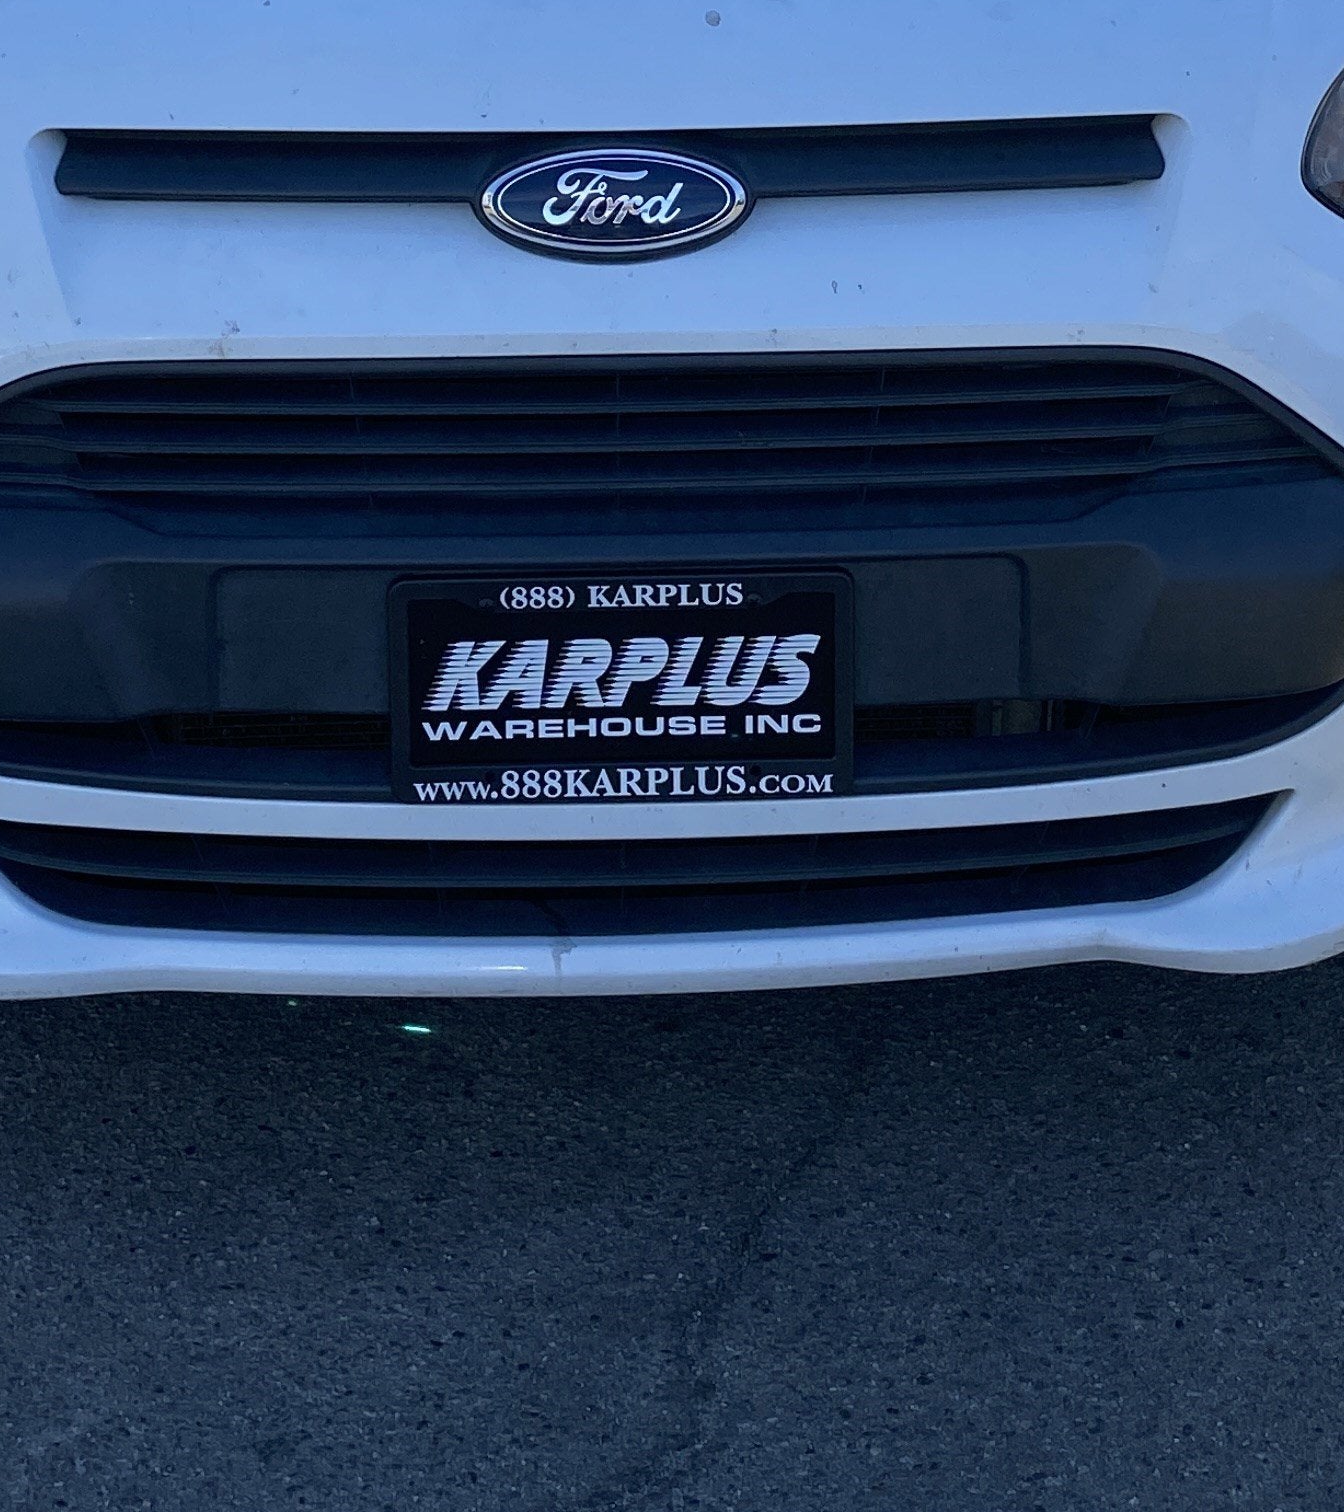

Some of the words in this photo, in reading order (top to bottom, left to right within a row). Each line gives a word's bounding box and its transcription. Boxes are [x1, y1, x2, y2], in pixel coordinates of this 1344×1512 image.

[542, 168, 683, 225] Ford
[499, 586, 576, 609] (888)
[587, 582, 744, 608] KARPLUS
[421, 634, 821, 711] KARPLUS
[421, 716, 726, 740] WAREHOUSE
[745, 713, 822, 734] INC
